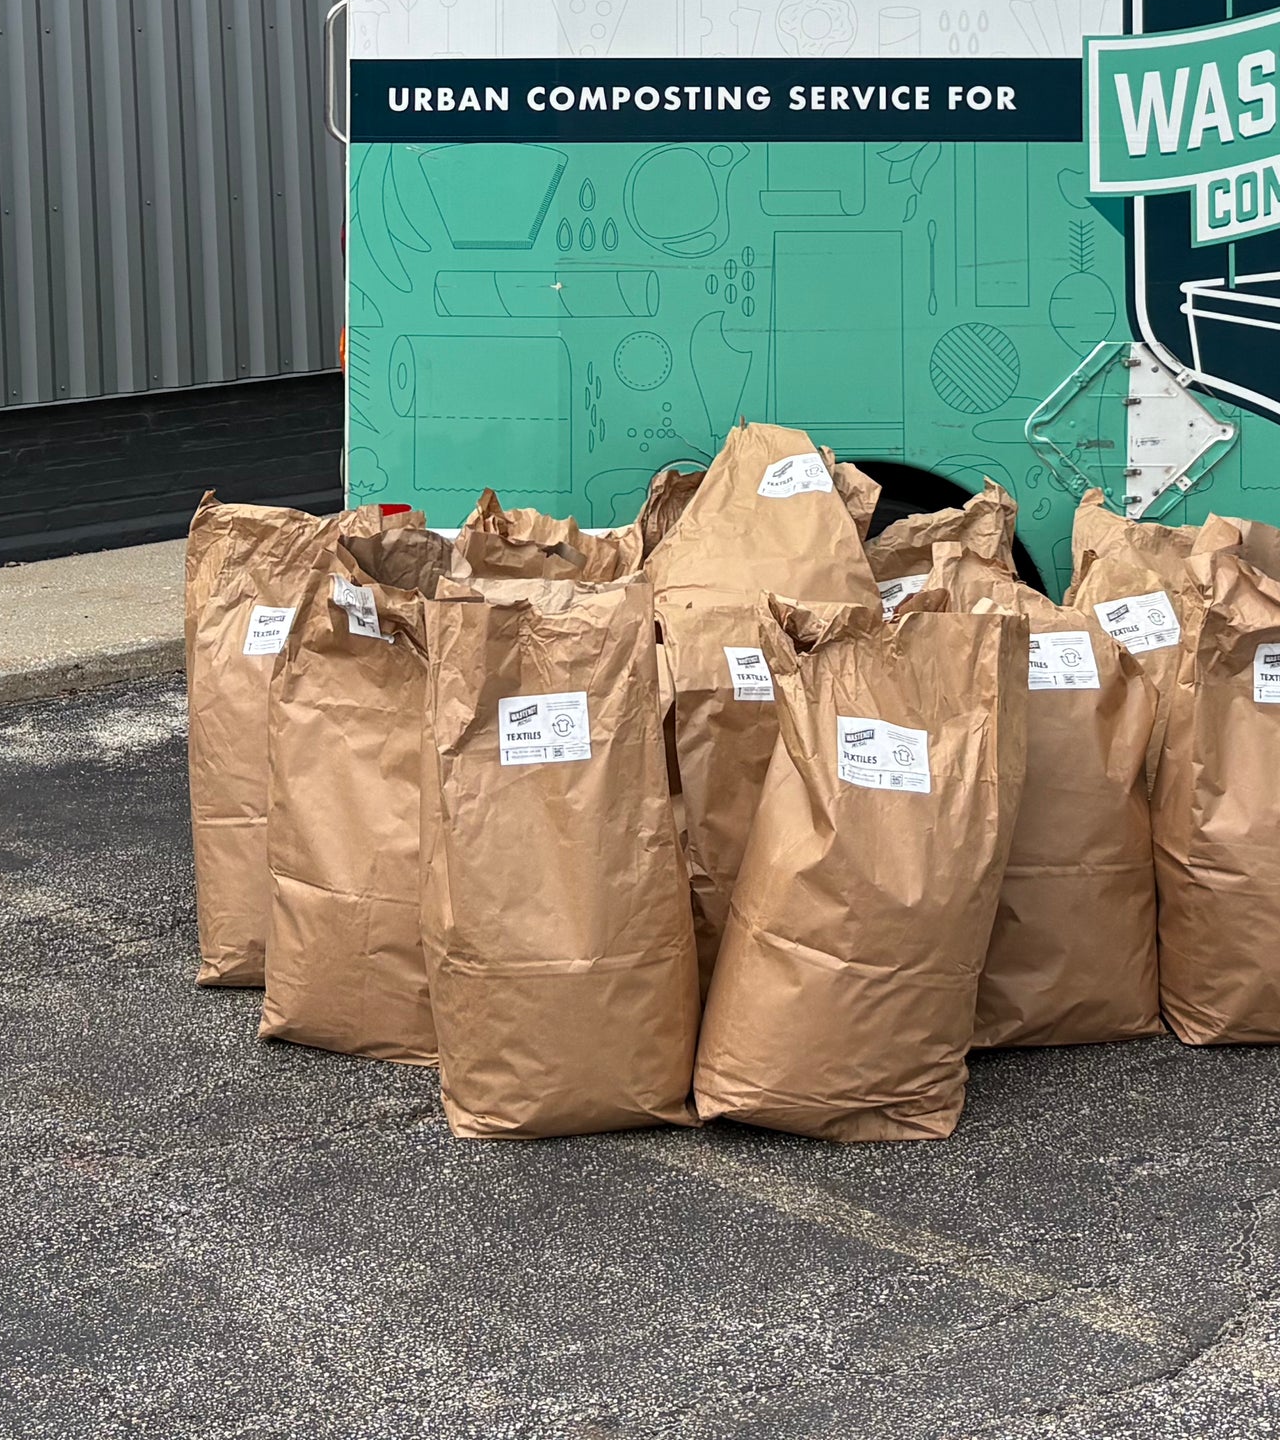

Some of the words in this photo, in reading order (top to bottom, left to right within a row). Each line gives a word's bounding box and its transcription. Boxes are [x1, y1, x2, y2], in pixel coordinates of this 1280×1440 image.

[389, 87, 508, 111] URBAN
[528, 86, 770, 110] COMPOSTING
[790, 86, 929, 110] SERVICE
[949, 86, 1016, 110] FOR
[506, 731, 542, 741] TEXTILES
[843, 750, 878, 765] TEXTILES
